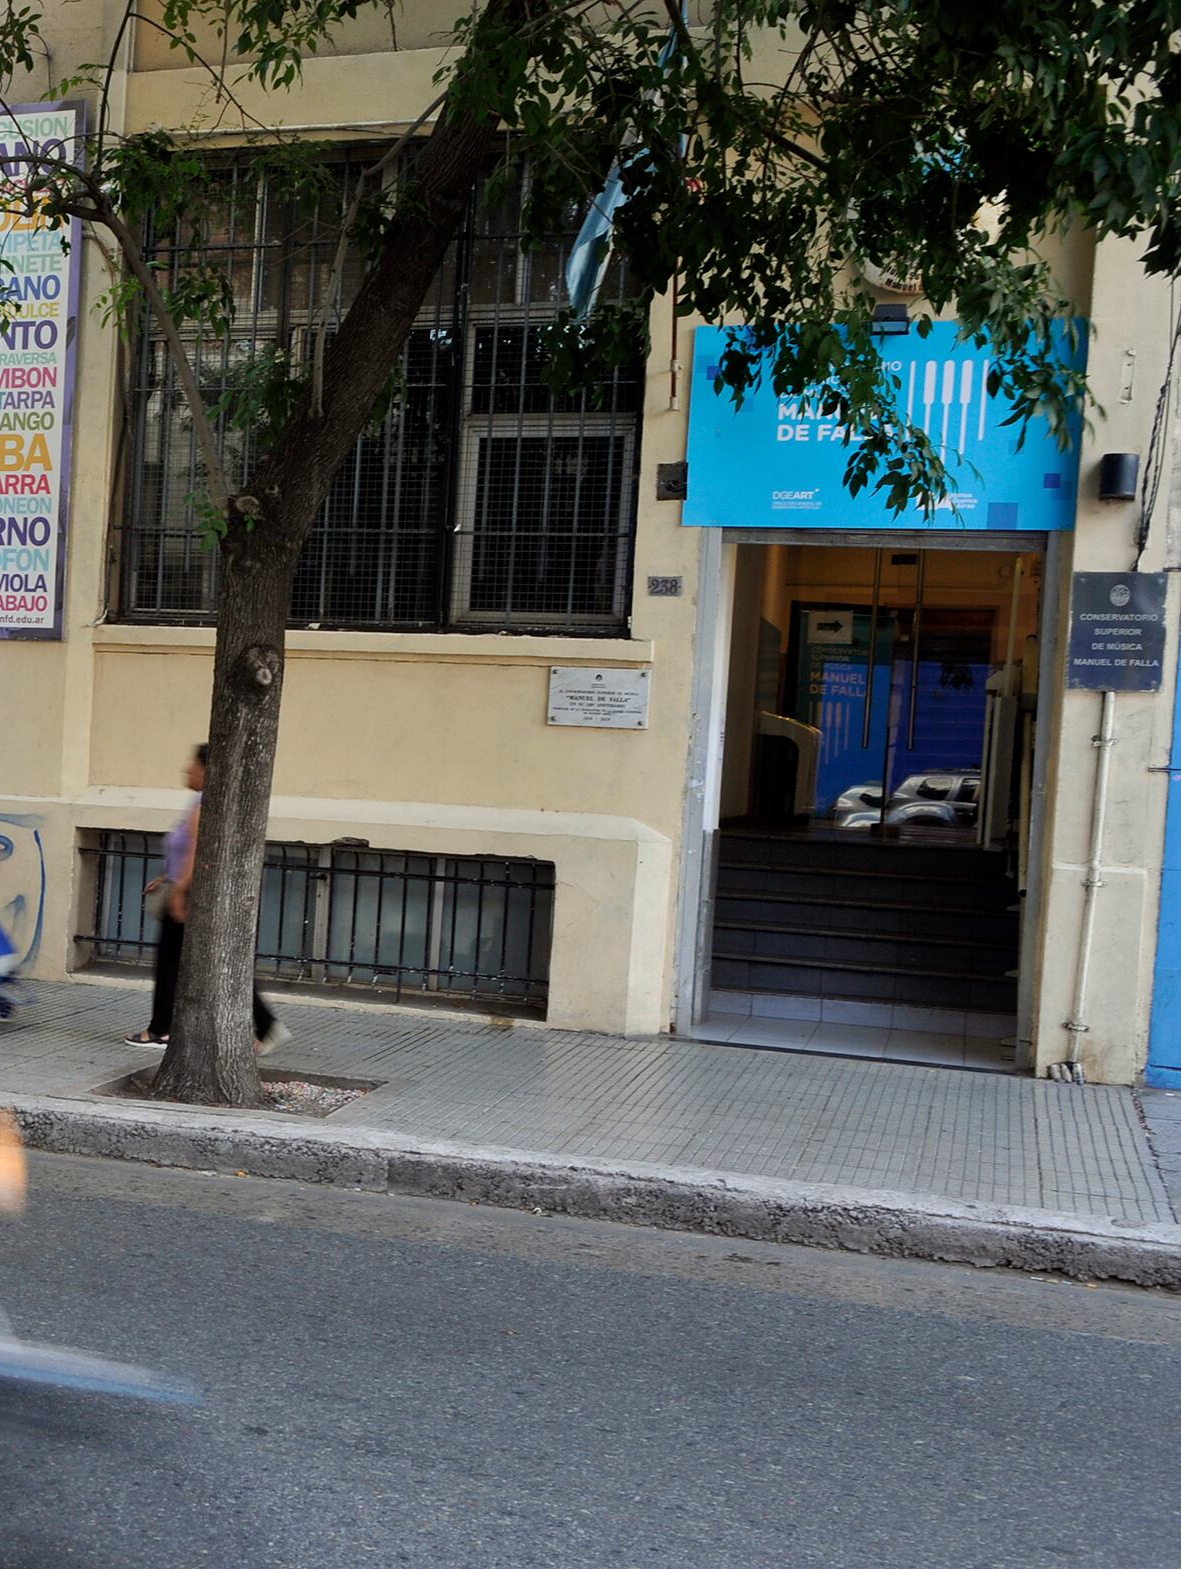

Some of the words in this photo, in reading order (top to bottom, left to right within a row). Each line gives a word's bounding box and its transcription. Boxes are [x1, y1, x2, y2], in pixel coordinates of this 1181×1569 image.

[777, 424, 811, 441] DE
[650, 579, 678, 595] 238
[1079, 613, 1159, 621] CONSERVATORIO
[1094, 628, 1142, 636] SUPERIOR
[1107, 641, 1143, 650] MÚSICA
[1073, 658, 1112, 666] MANUEL
[1129, 659, 1159, 667] FALLA
[810, 671, 866, 685] MANUEL
[809, 684, 827, 695] DE
